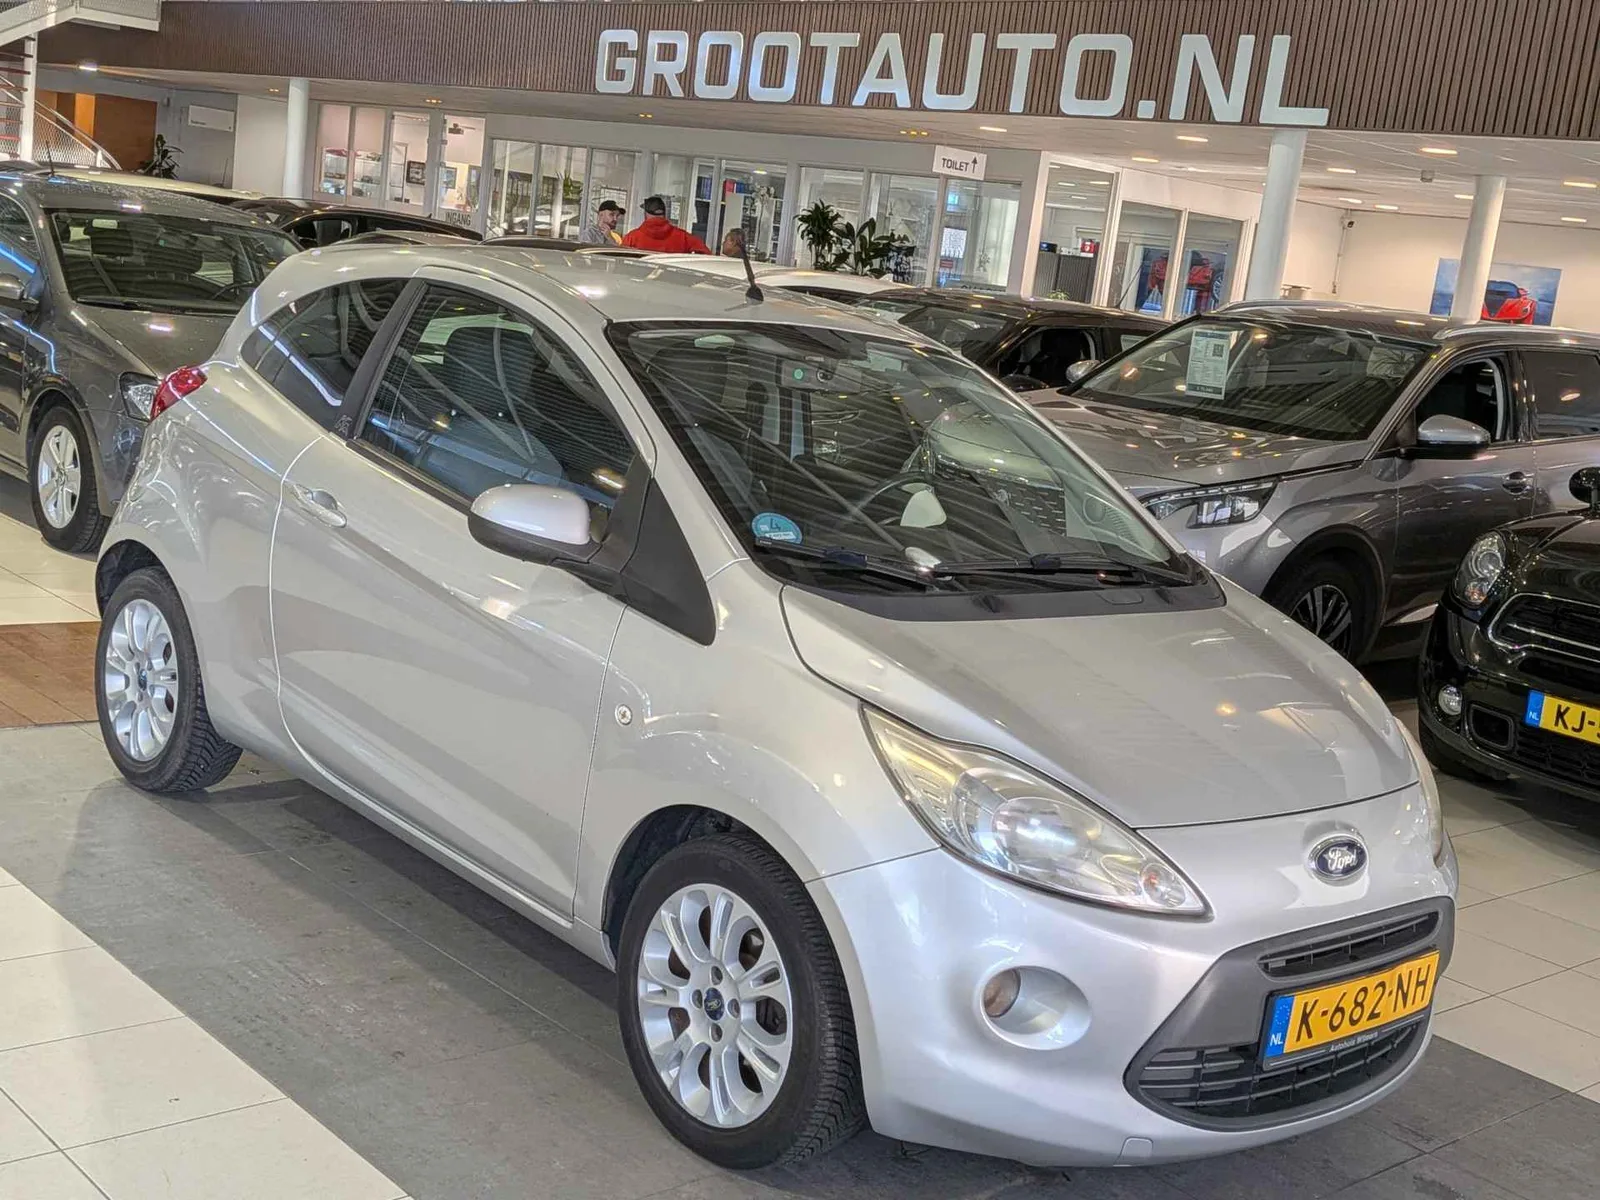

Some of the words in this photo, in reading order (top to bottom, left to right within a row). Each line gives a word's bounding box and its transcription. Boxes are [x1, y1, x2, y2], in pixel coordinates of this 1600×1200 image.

[595, 29, 1330, 126] GROOTAUTO.NL
[942, 157, 969, 172] TOILET
[446, 211, 471, 227] INGANG
[1529, 711, 1539, 721] NL
[1554, 703, 1600, 739] KJ-
[1323, 845, 1357, 870] Ford
[1296, 963, 1430, 1042] K-682-NH
[1270, 1033, 1283, 1047] NL
